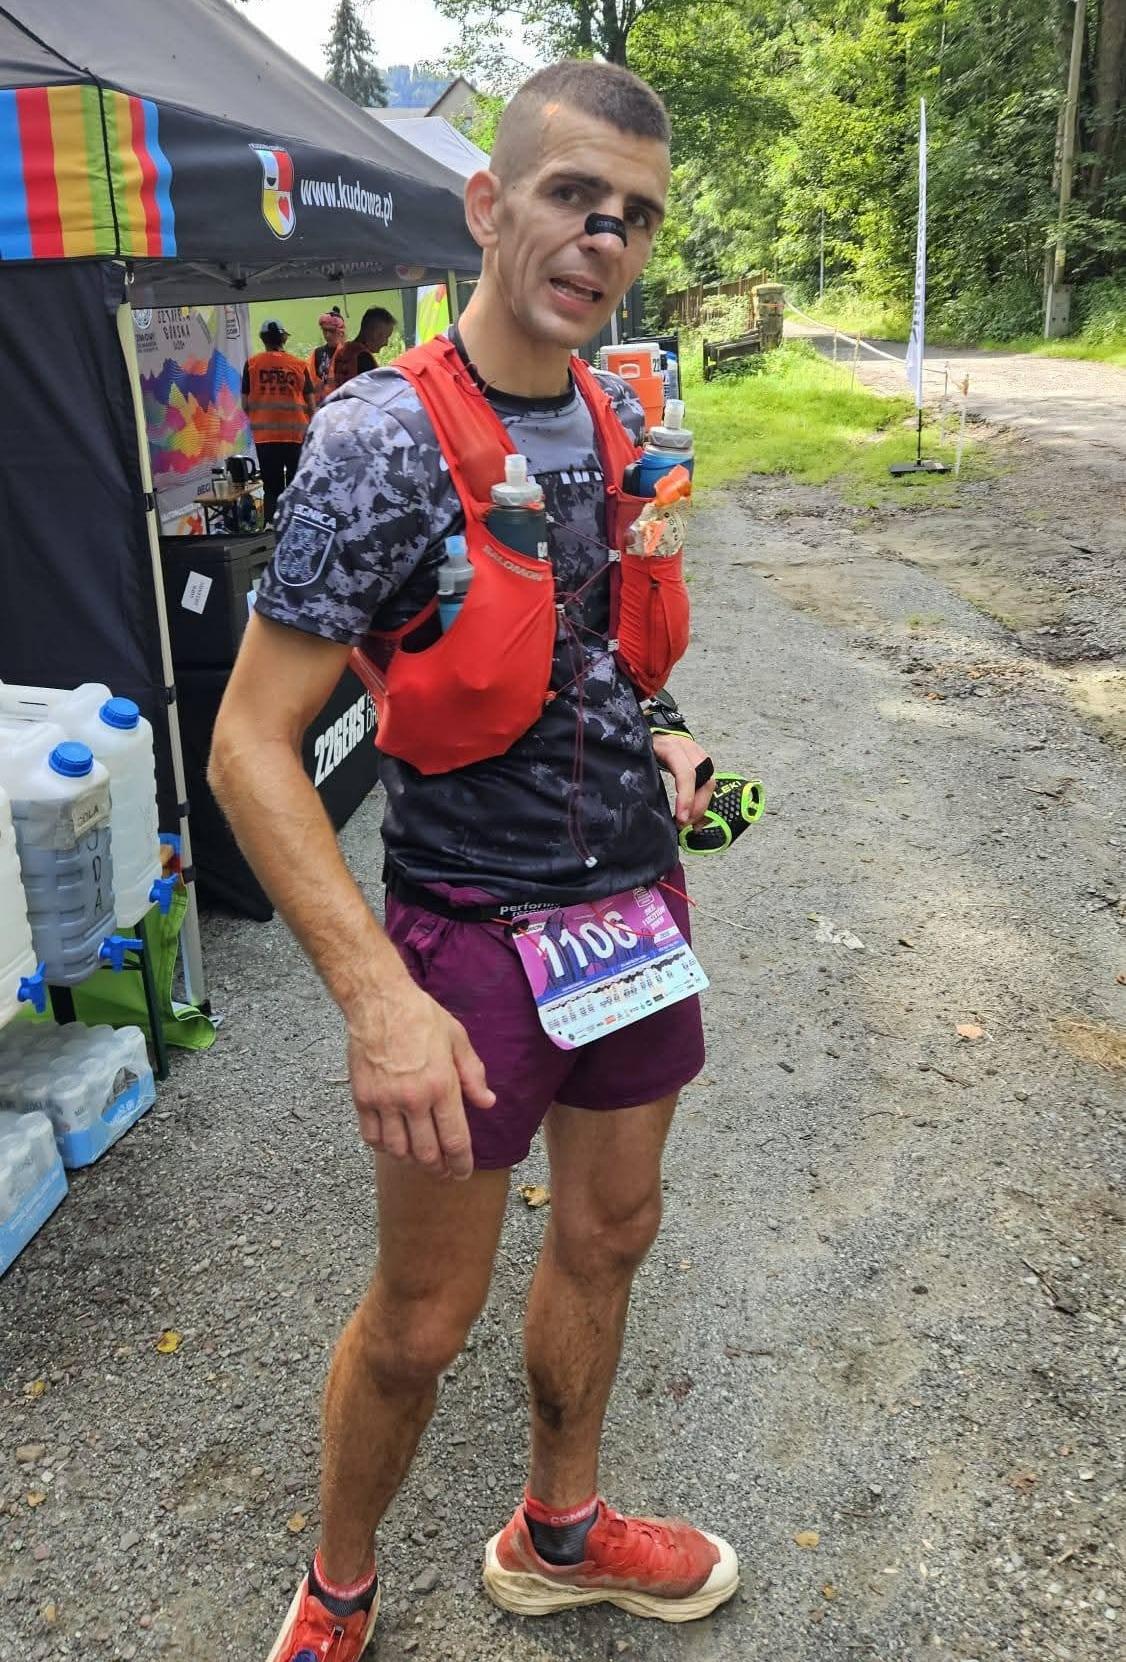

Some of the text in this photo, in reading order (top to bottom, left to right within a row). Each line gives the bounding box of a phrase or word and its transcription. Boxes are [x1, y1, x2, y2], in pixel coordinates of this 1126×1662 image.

[300, 175, 393, 227] www.kudowa.pl
[314, 692, 366, 788] 226ERS
[713, 780, 742, 799] LEKI
[536, 911, 638, 978] 1106
